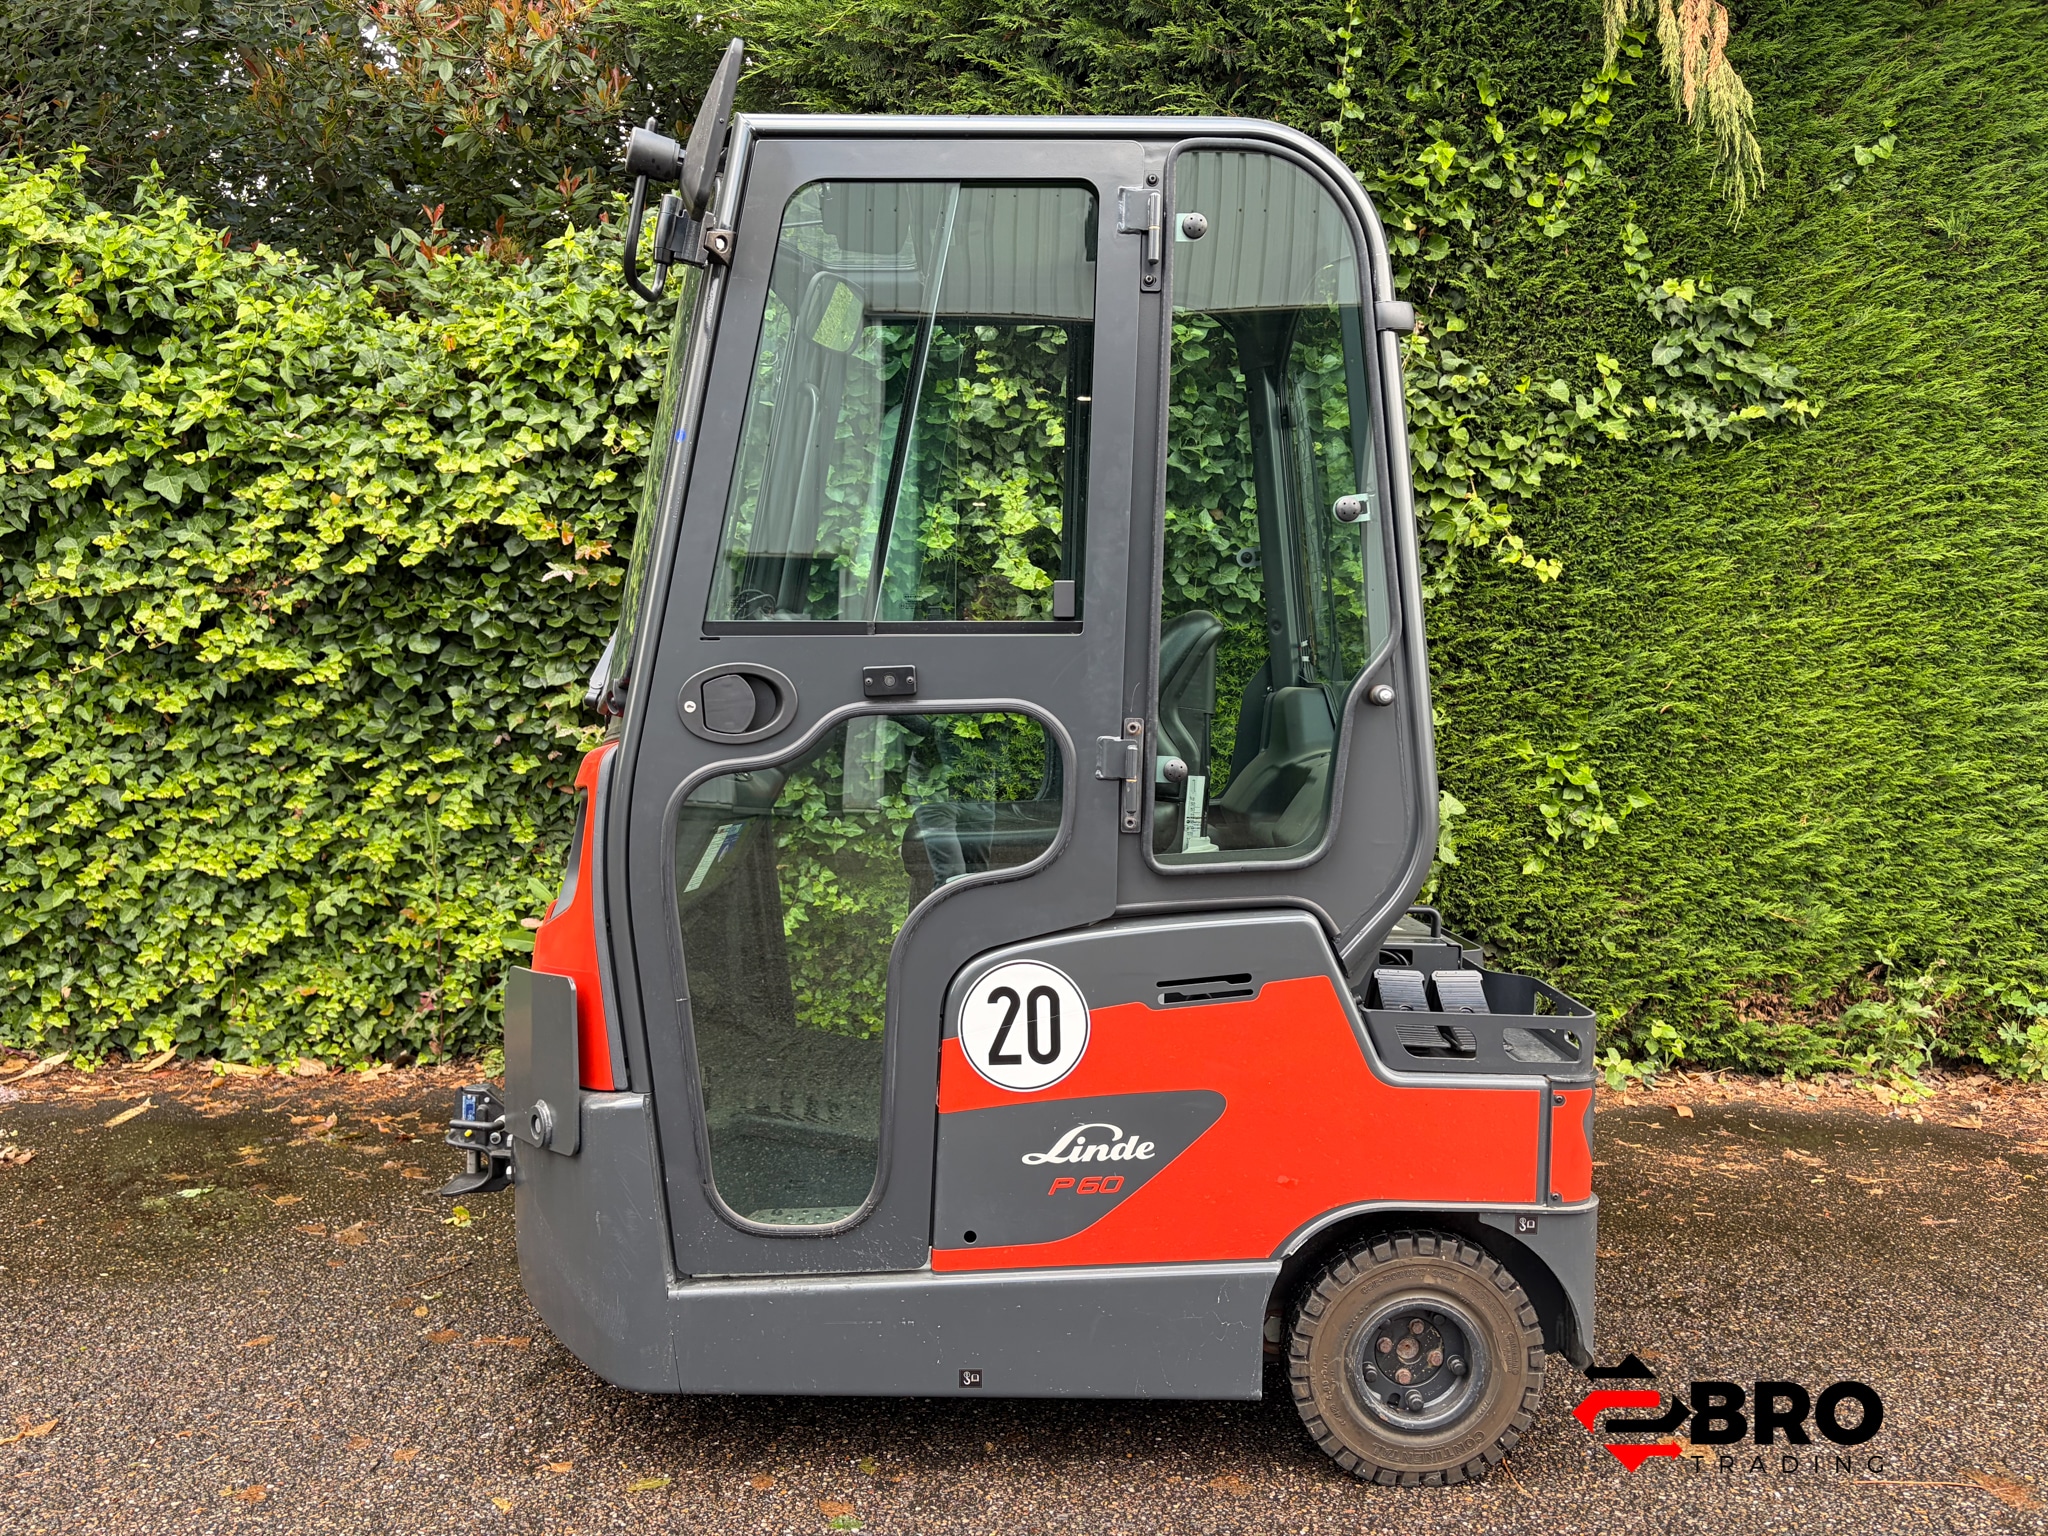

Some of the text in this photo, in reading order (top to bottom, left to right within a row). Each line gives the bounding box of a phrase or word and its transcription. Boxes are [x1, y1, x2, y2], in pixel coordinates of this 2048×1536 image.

[987, 985, 1062, 1066] 20
[1021, 1123, 1156, 1166] Linde
[1372, 1431, 1485, 1464] CONTINENTAL
